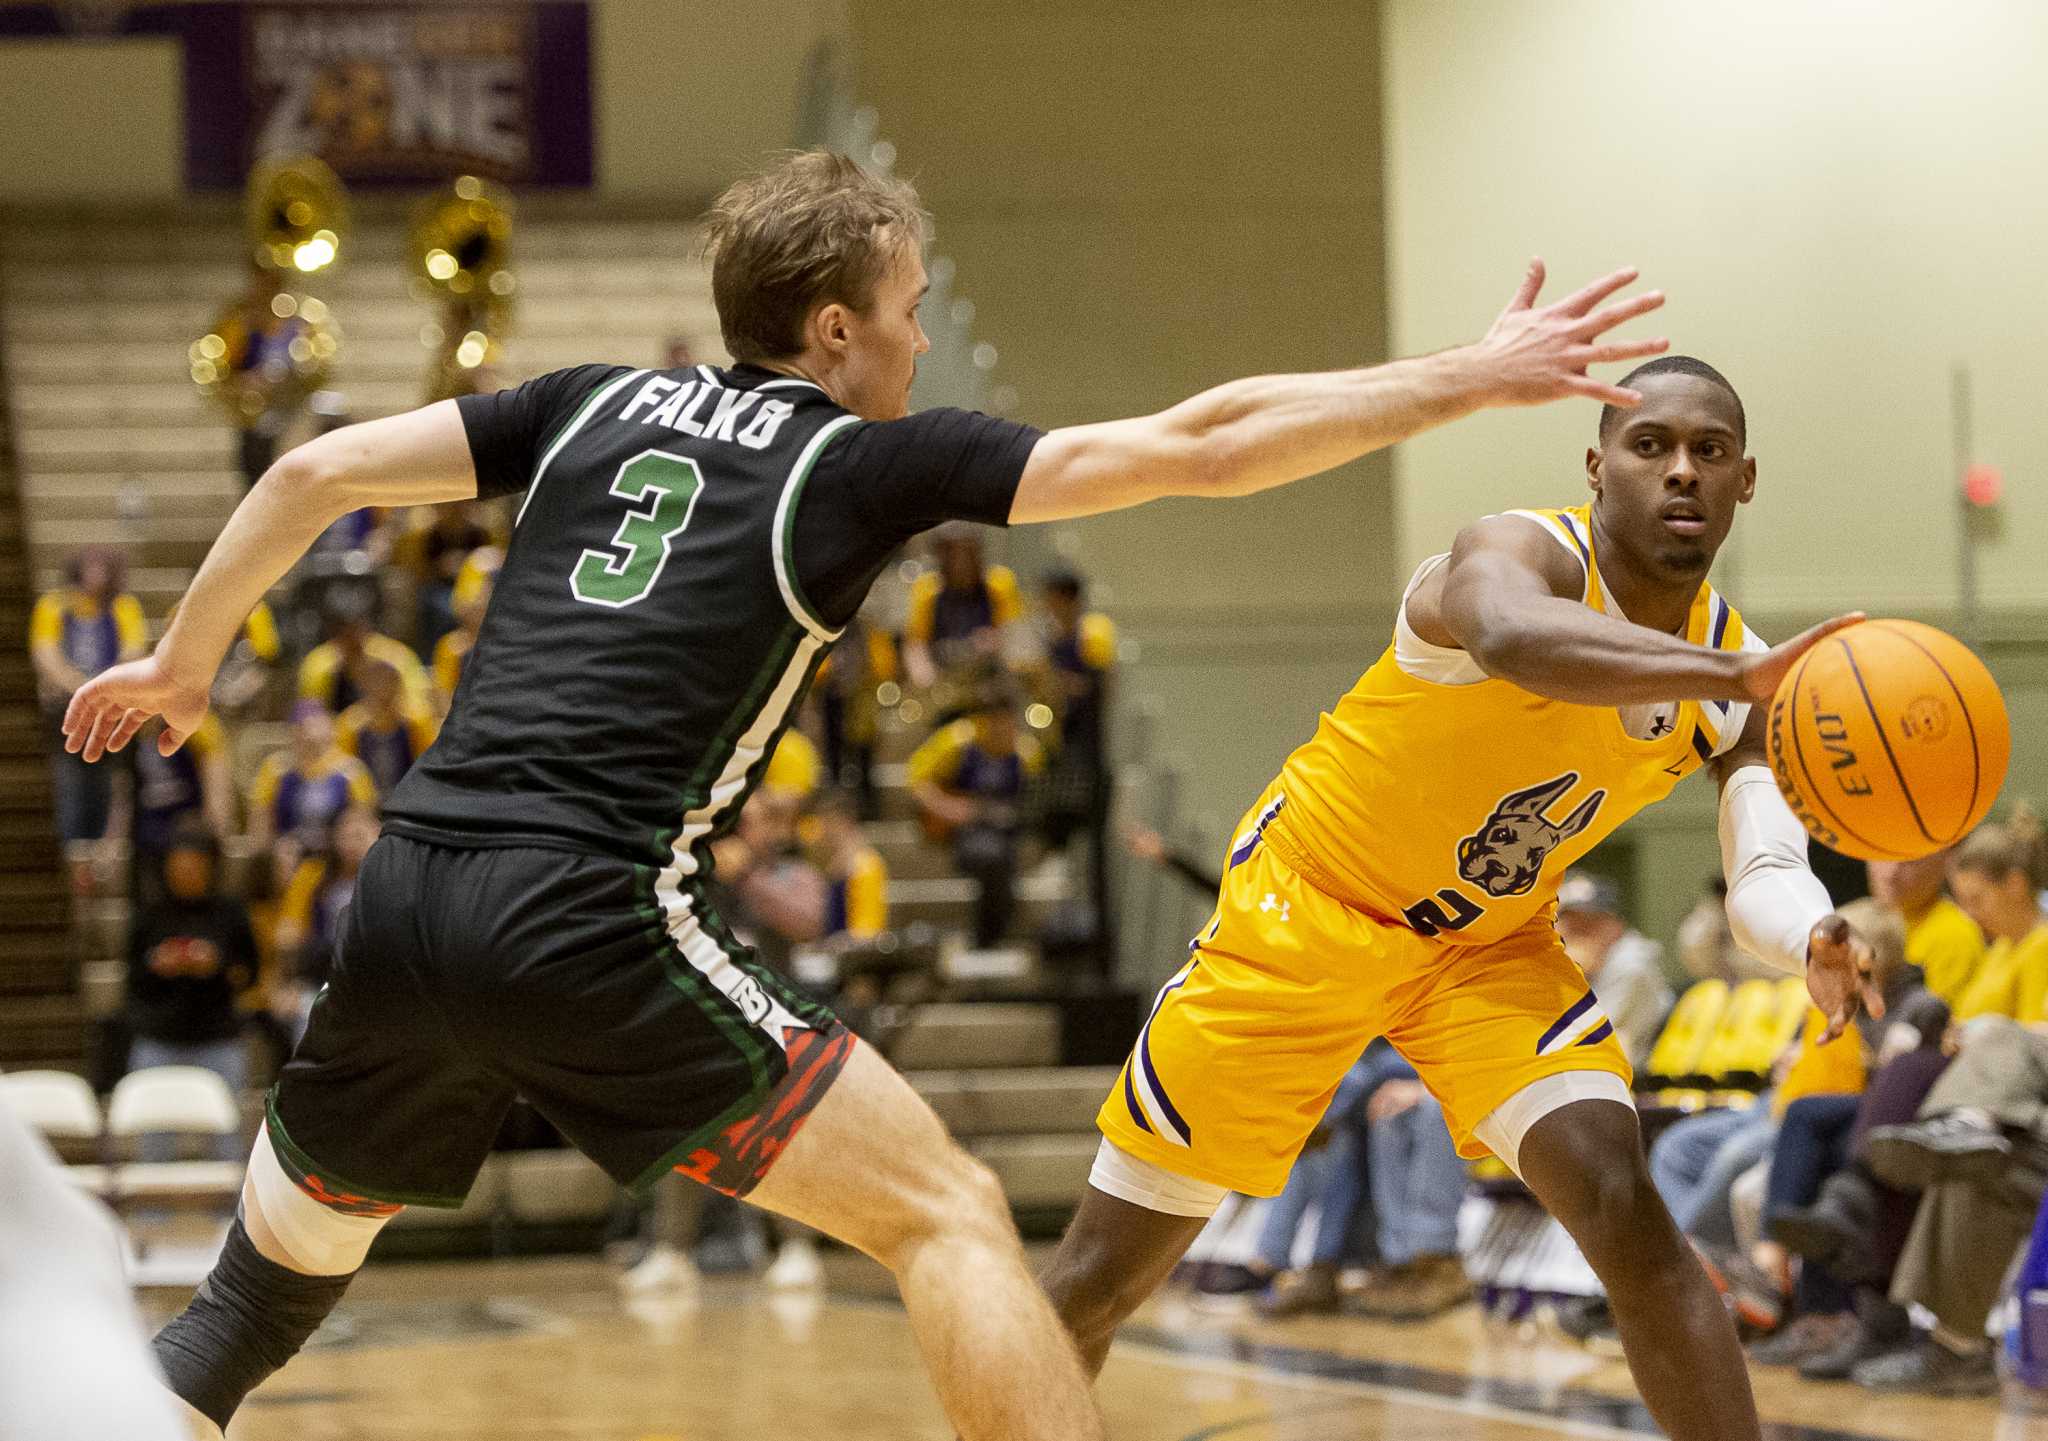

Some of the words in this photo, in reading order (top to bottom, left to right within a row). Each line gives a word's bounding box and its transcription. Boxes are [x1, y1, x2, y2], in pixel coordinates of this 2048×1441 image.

[619, 375, 794, 450] FALKO
[569, 448, 705, 608] 3
[1815, 714, 1873, 797] EVO
